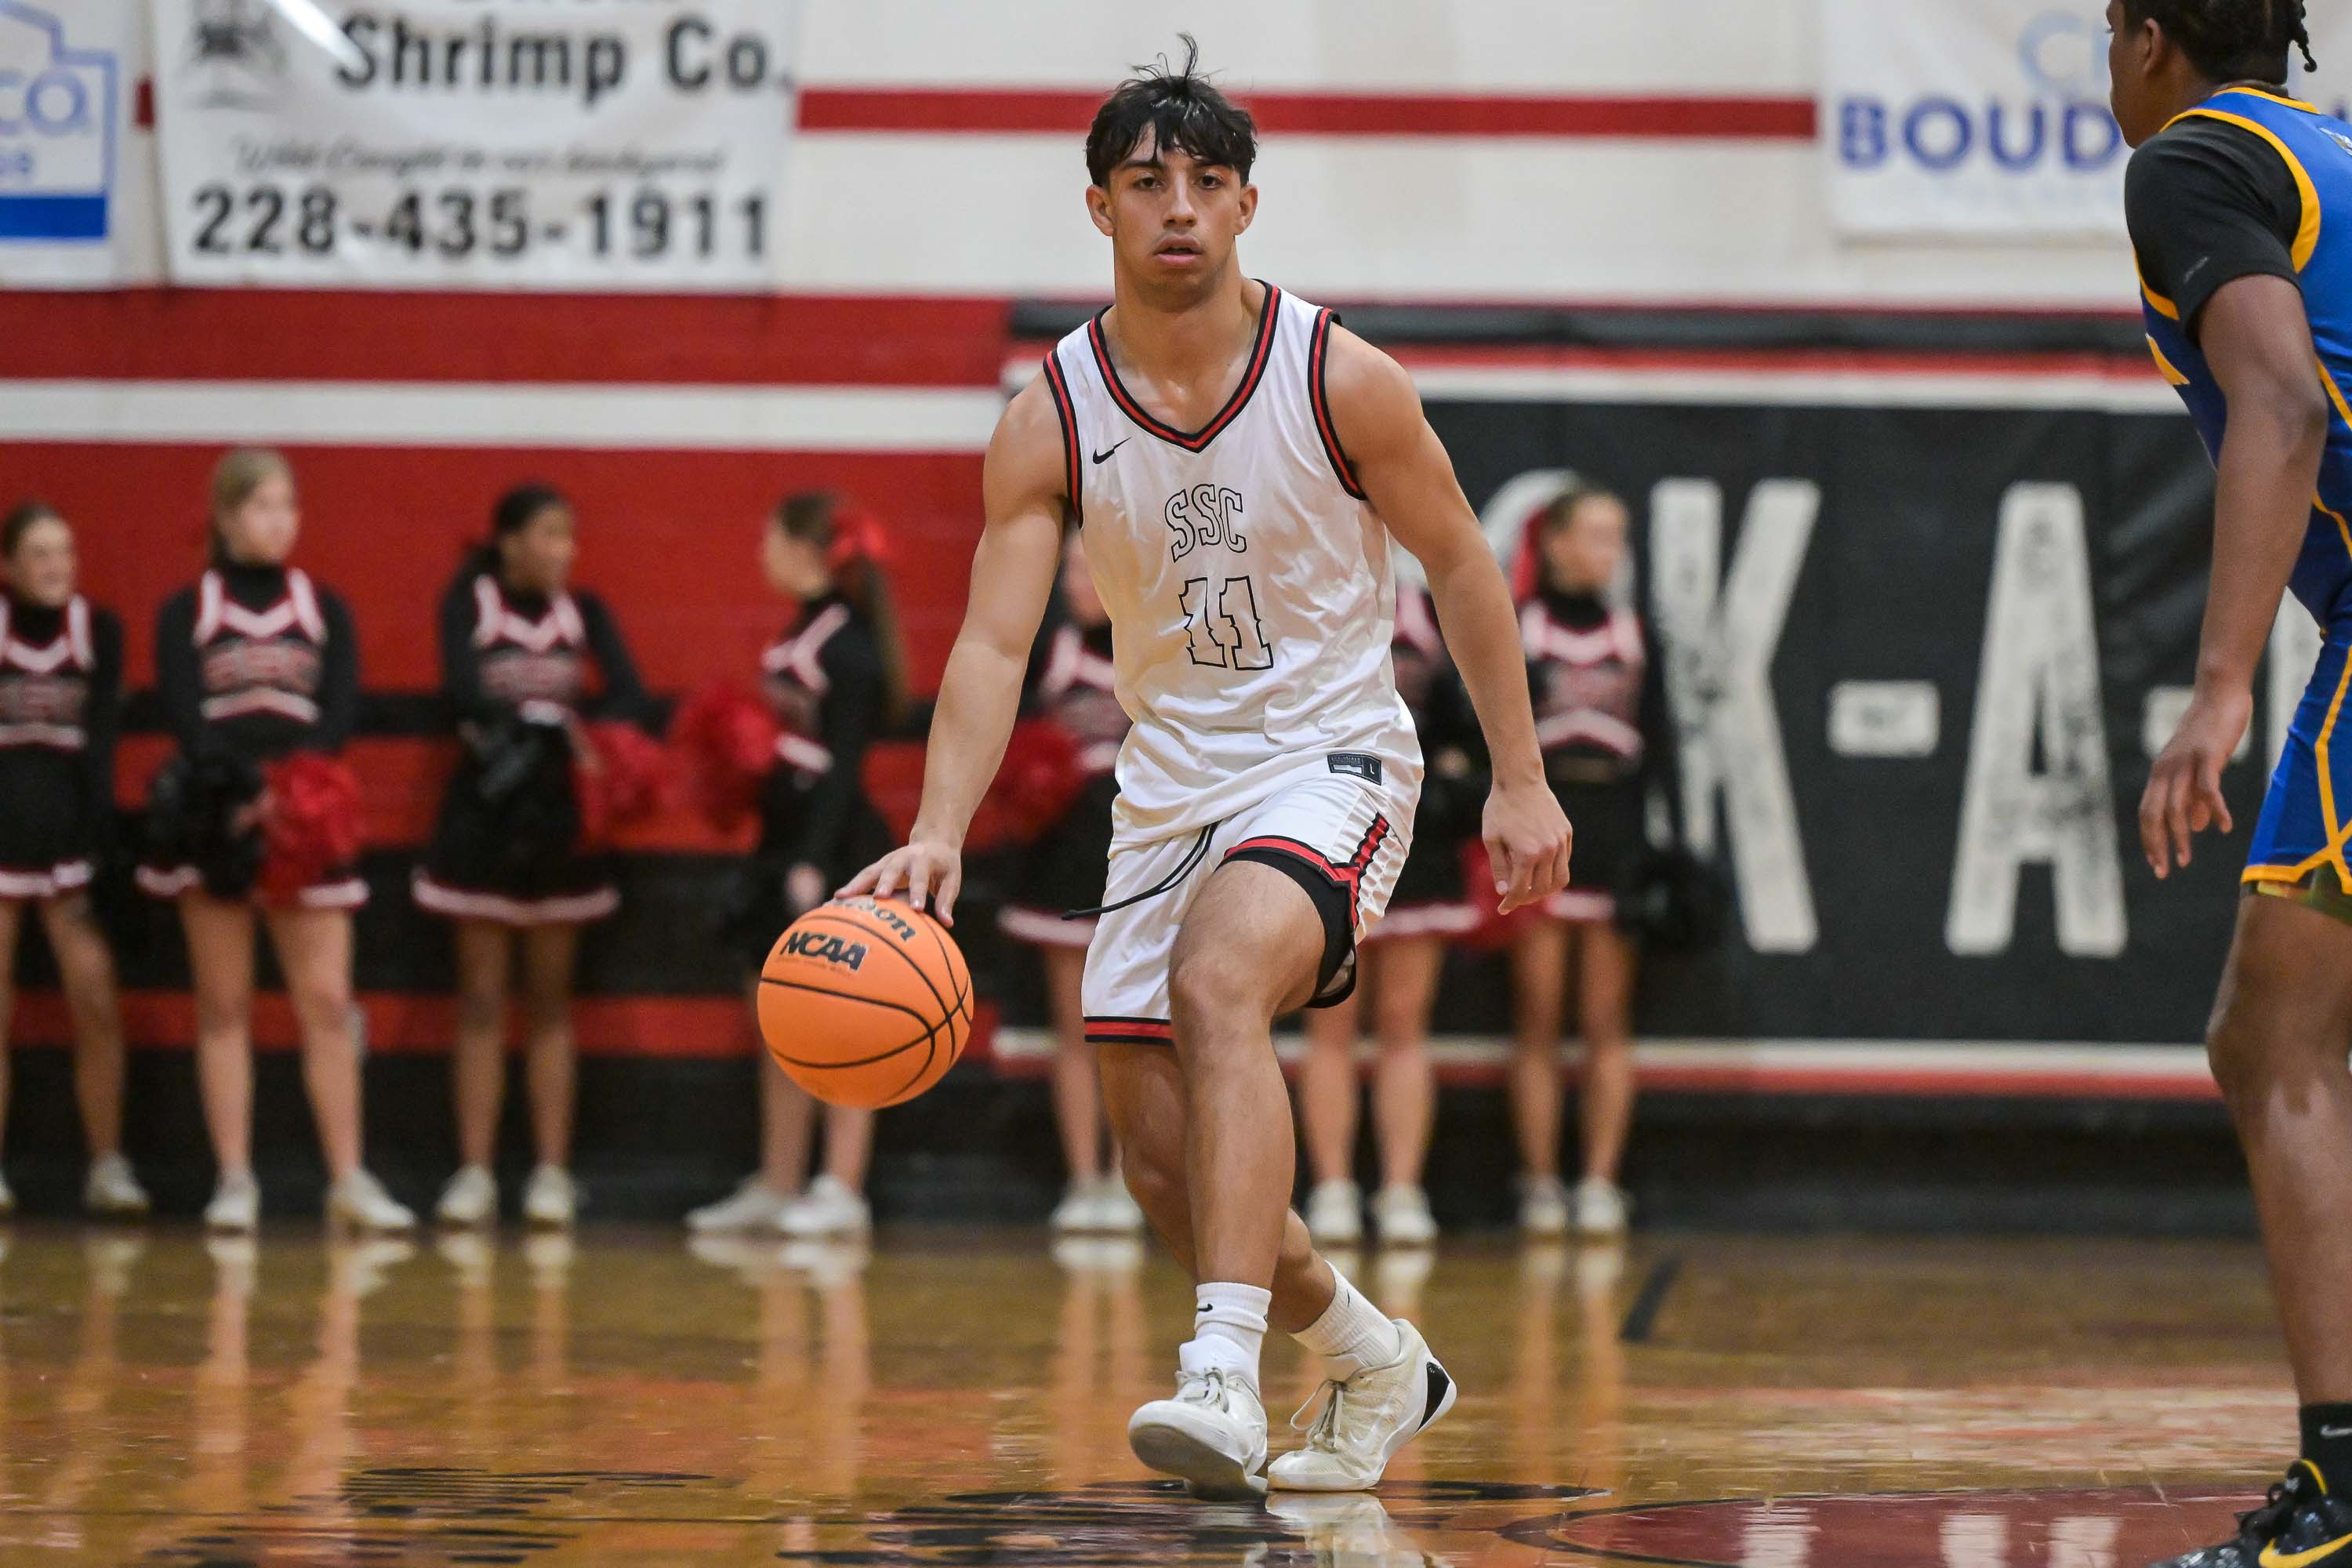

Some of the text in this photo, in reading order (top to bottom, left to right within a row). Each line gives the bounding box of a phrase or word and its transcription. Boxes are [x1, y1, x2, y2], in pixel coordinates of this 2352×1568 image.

[336, 13, 626, 108] Shrimp
[1838, 97, 2122, 171] BOUD
[192, 183, 768, 257] 228-435-1911
[1164, 483, 1247, 563] SSC
[1178, 575, 1274, 671] 11
[780, 931, 866, 971] NCAA
